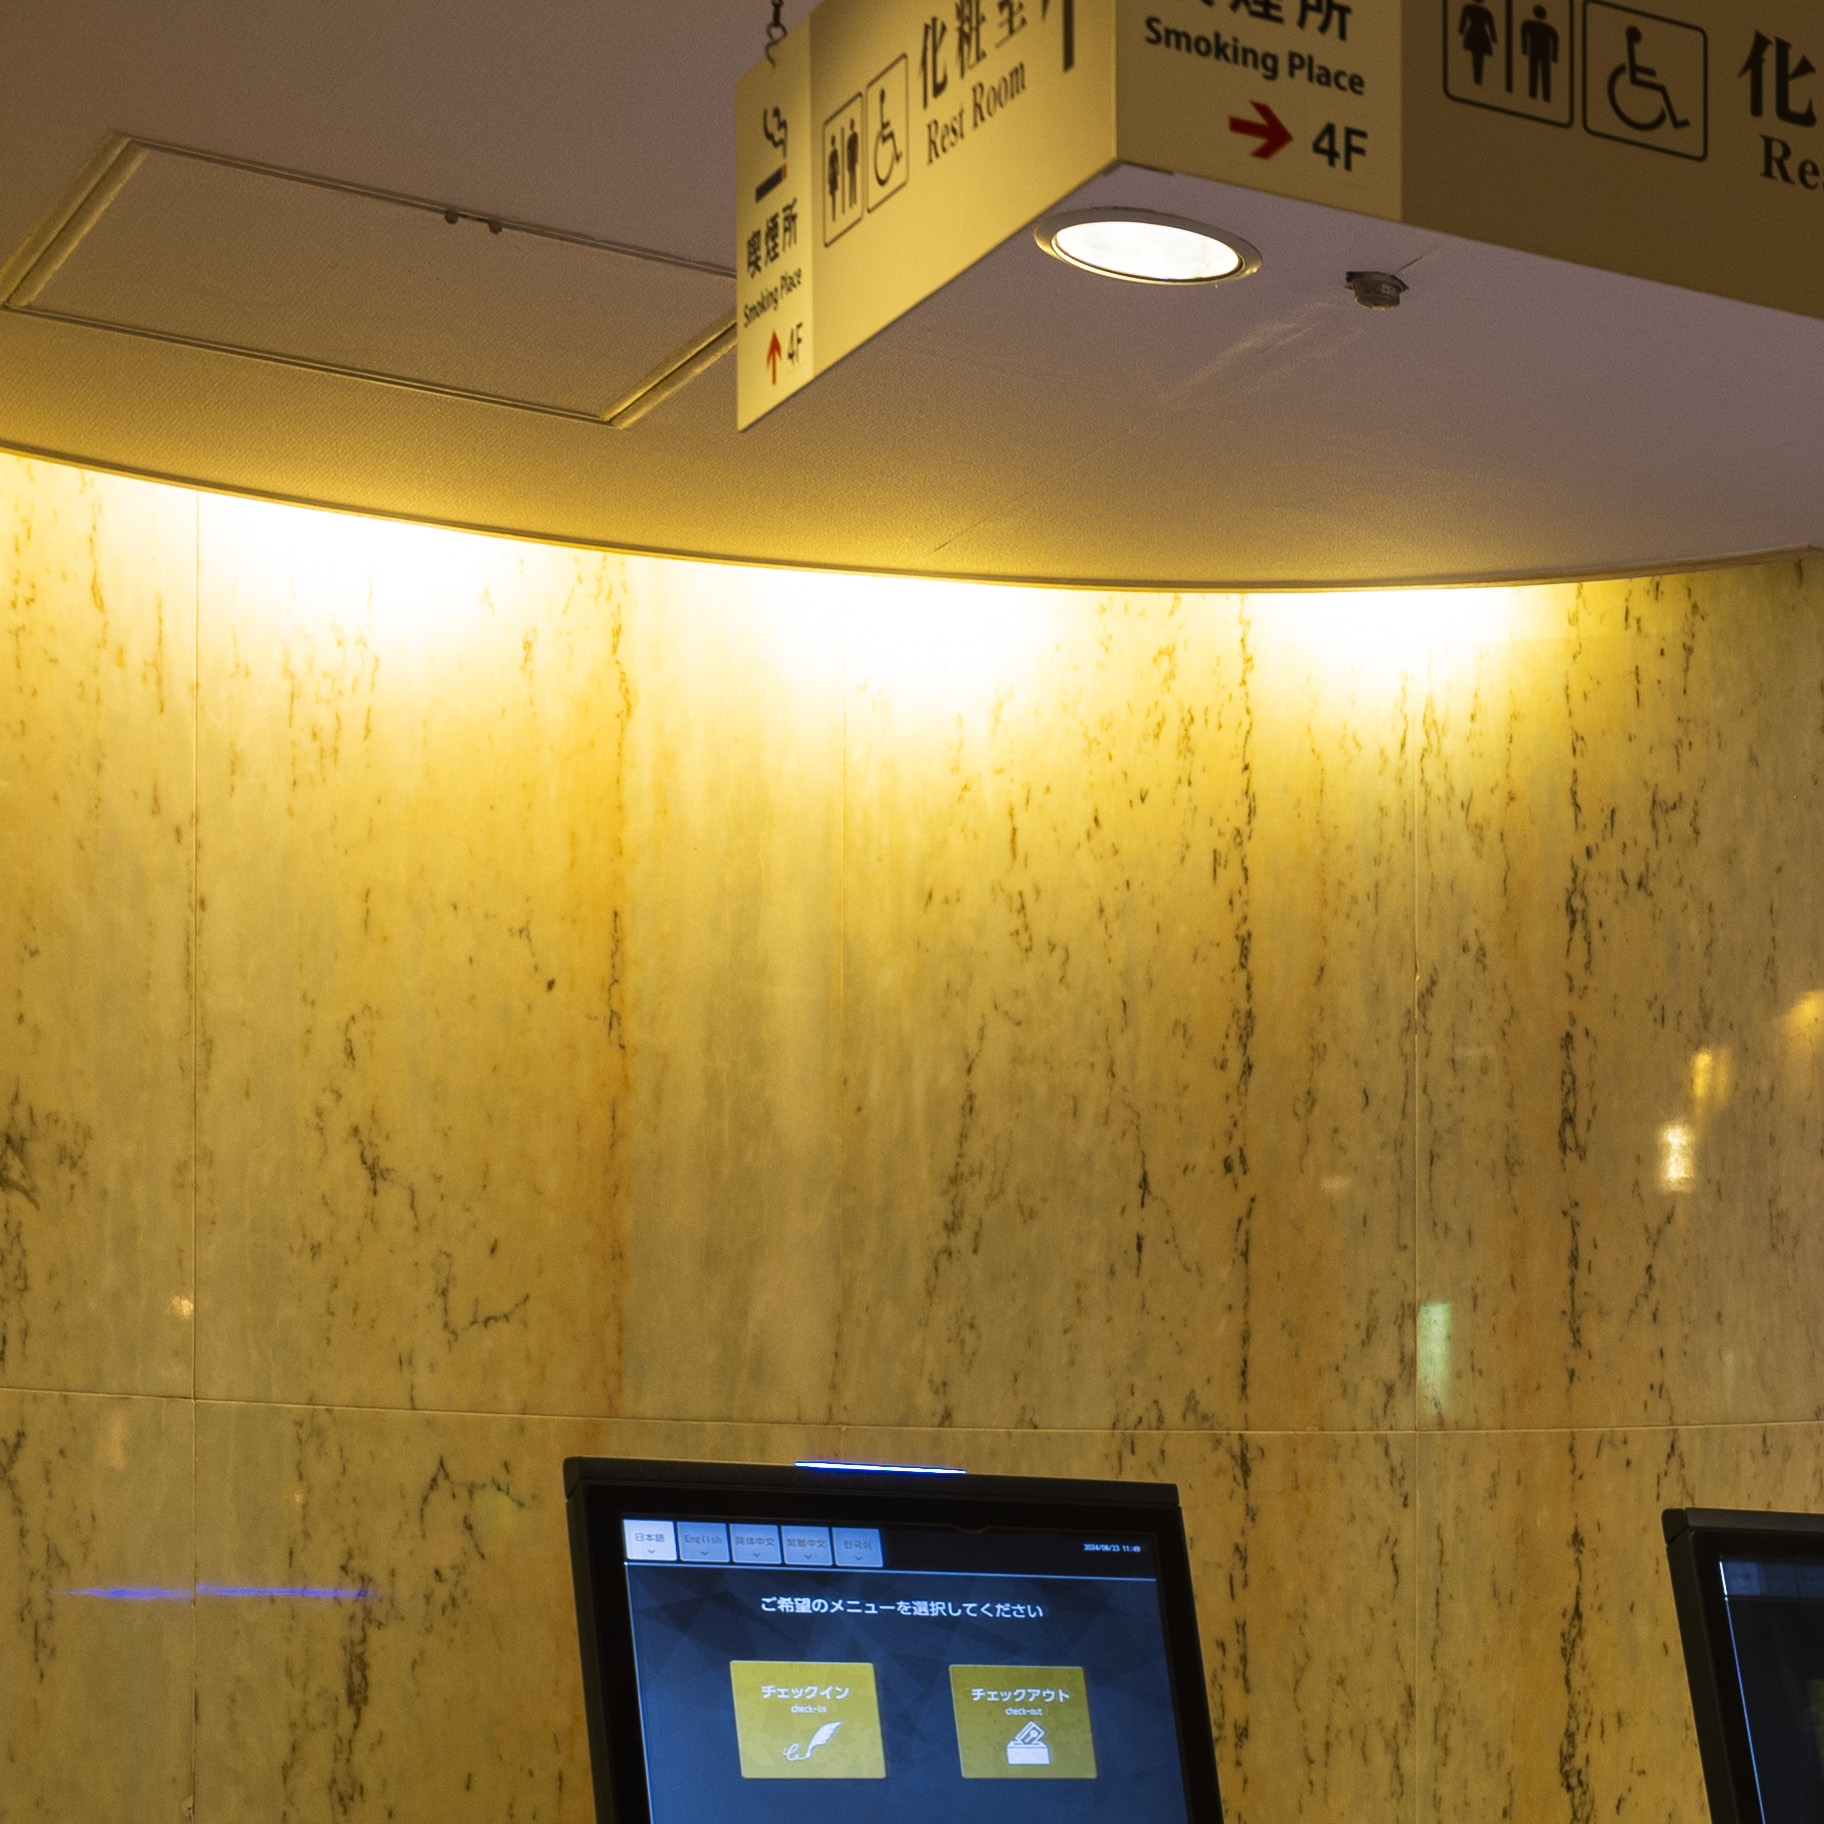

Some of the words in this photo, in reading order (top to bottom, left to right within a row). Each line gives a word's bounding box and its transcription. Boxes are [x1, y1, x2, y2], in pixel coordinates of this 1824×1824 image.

[1144, 16, 1279, 81] Smoking
[1288, 50, 1365, 96] Place
[927, 103, 965, 165] Rest
[972, 61, 1026, 130] Room
[1312, 122, 1368, 173] 4F
[746, 197, 797, 279] 喫煙所
[744, 286, 778, 328] Smoking
[781, 268, 802, 299] Place
[788, 322, 802, 365] 4F
[684, 1534, 722, 1545] English
[761, 1596, 1044, 1619] ご希望のメニューを選択してください
[760, 1684, 850, 1700] チェックイン
[971, 1687, 1070, 1703] チェックアウト
